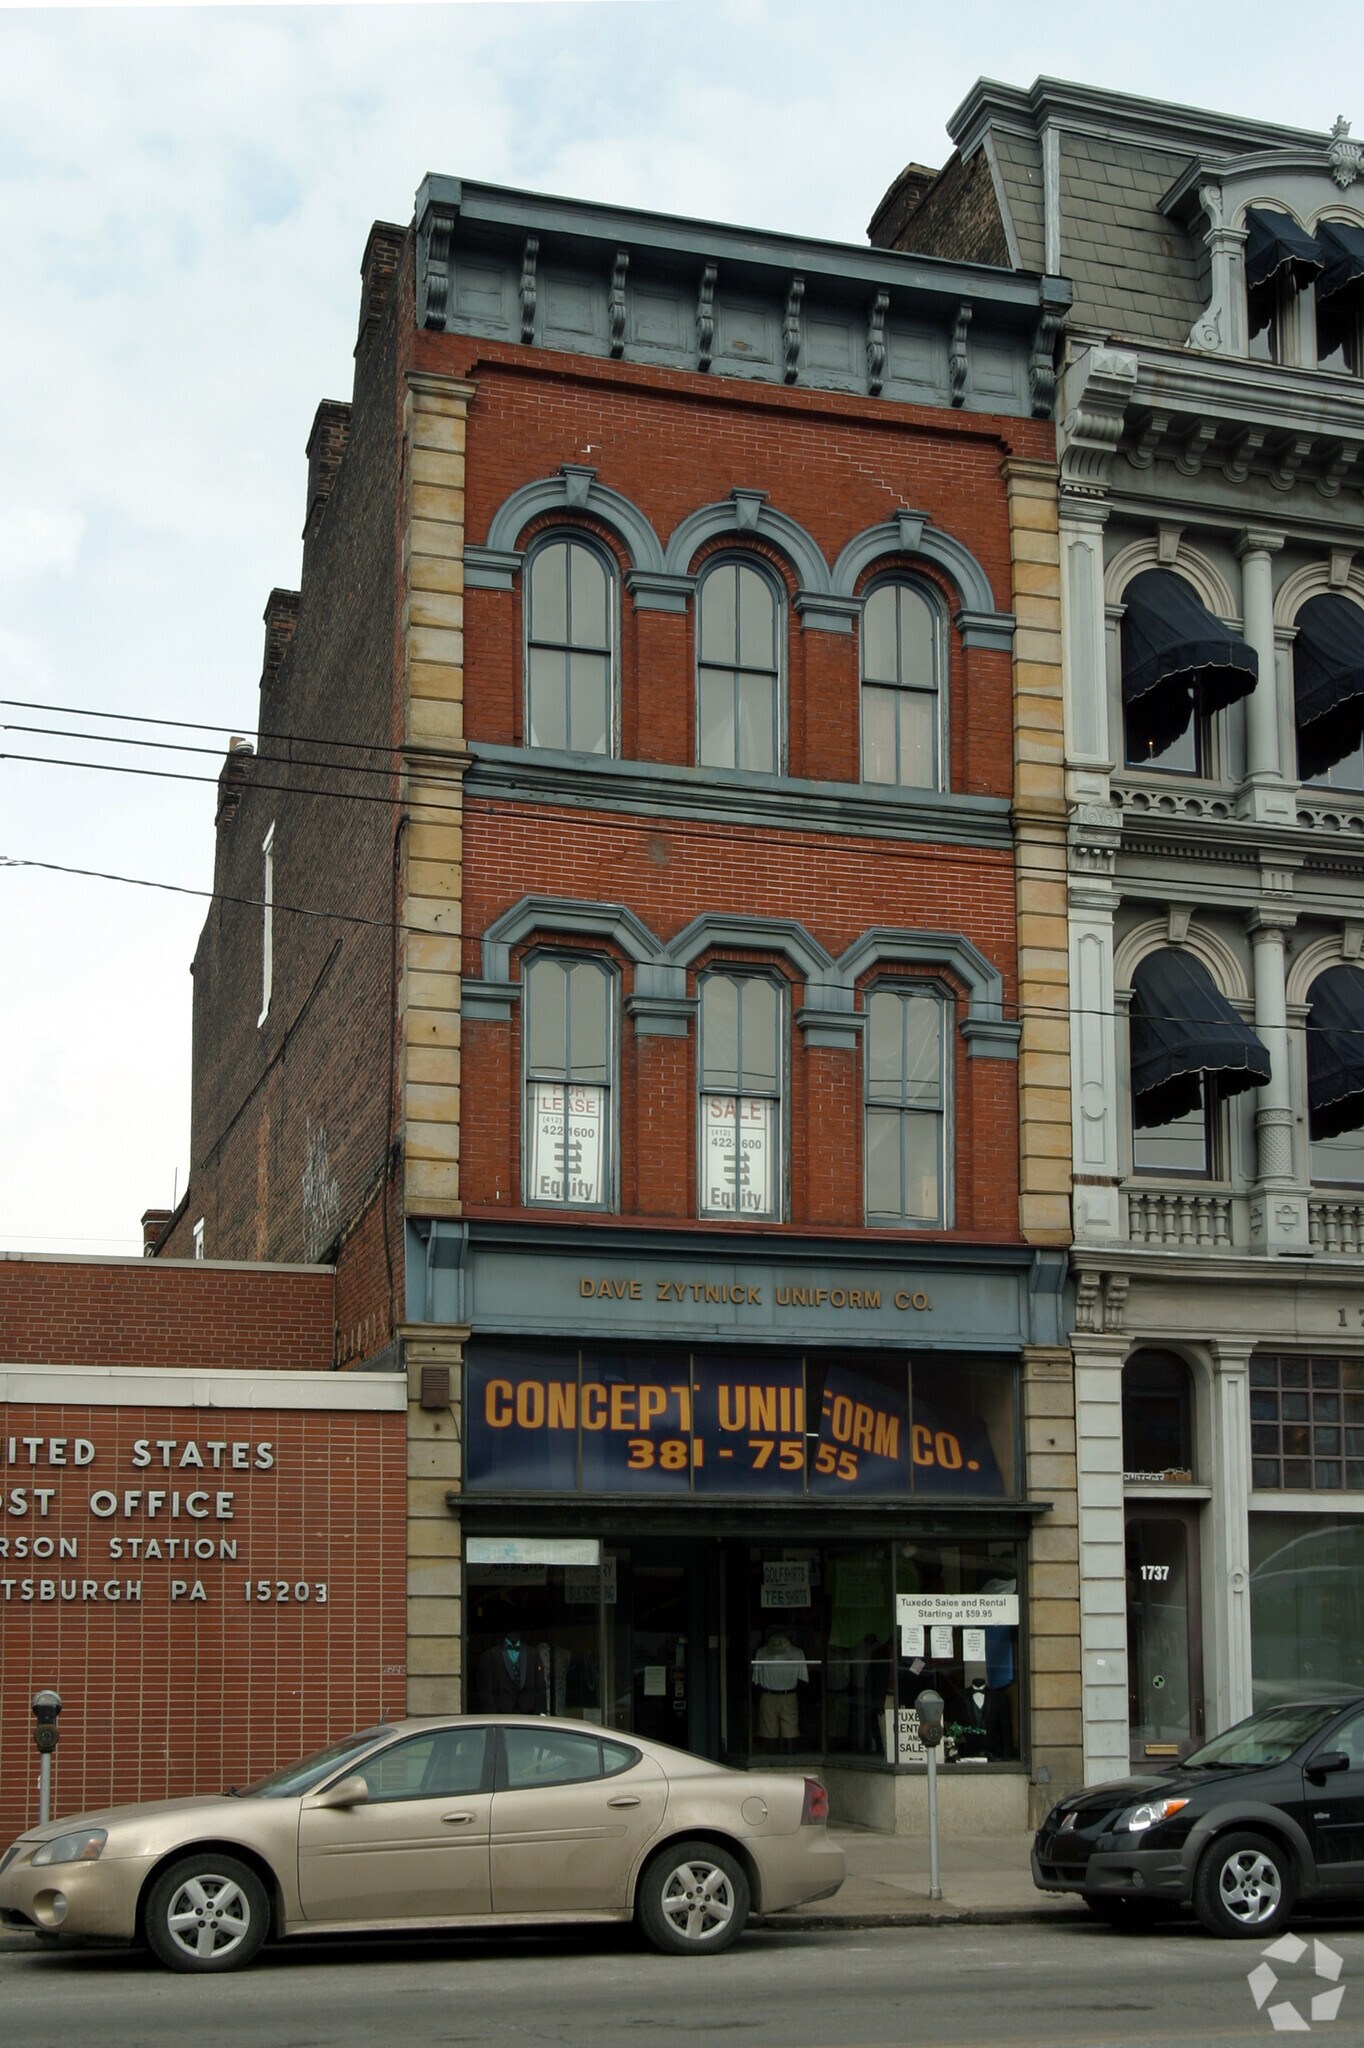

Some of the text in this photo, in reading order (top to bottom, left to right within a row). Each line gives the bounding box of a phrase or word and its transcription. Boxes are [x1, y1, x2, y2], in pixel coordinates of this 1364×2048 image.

[542, 1097, 596, 1113] LEASE
[710, 1097, 762, 1120] SALE
[542, 1116, 563, 1124] (412)
[542, 1125, 595, 1138] 4221600
[711, 1129, 731, 1137] (412)
[711, 1138, 762, 1149] 422-600
[540, 1175, 594, 1201] Equity
[579, 1278, 933, 1311] DAVE ZYTNICK UNIFORM CO.
[485, 1379, 700, 1431] CONCEPT
[911, 1424, 981, 1472] CO.
[132, 1439, 275, 1469] STATES
[0, 1487, 235, 1519] ST OFFICE
[109, 1537, 238, 1561] STATION
[1139, 1565, 1170, 1581] 1737
[171, 1580, 208, 1601] PA
[245, 1580, 328, 1603] 15203
[901, 1598, 1007, 1607] Tuxedo Sales and Rental
[918, 1609, 993, 1619] Starting at $59.95
